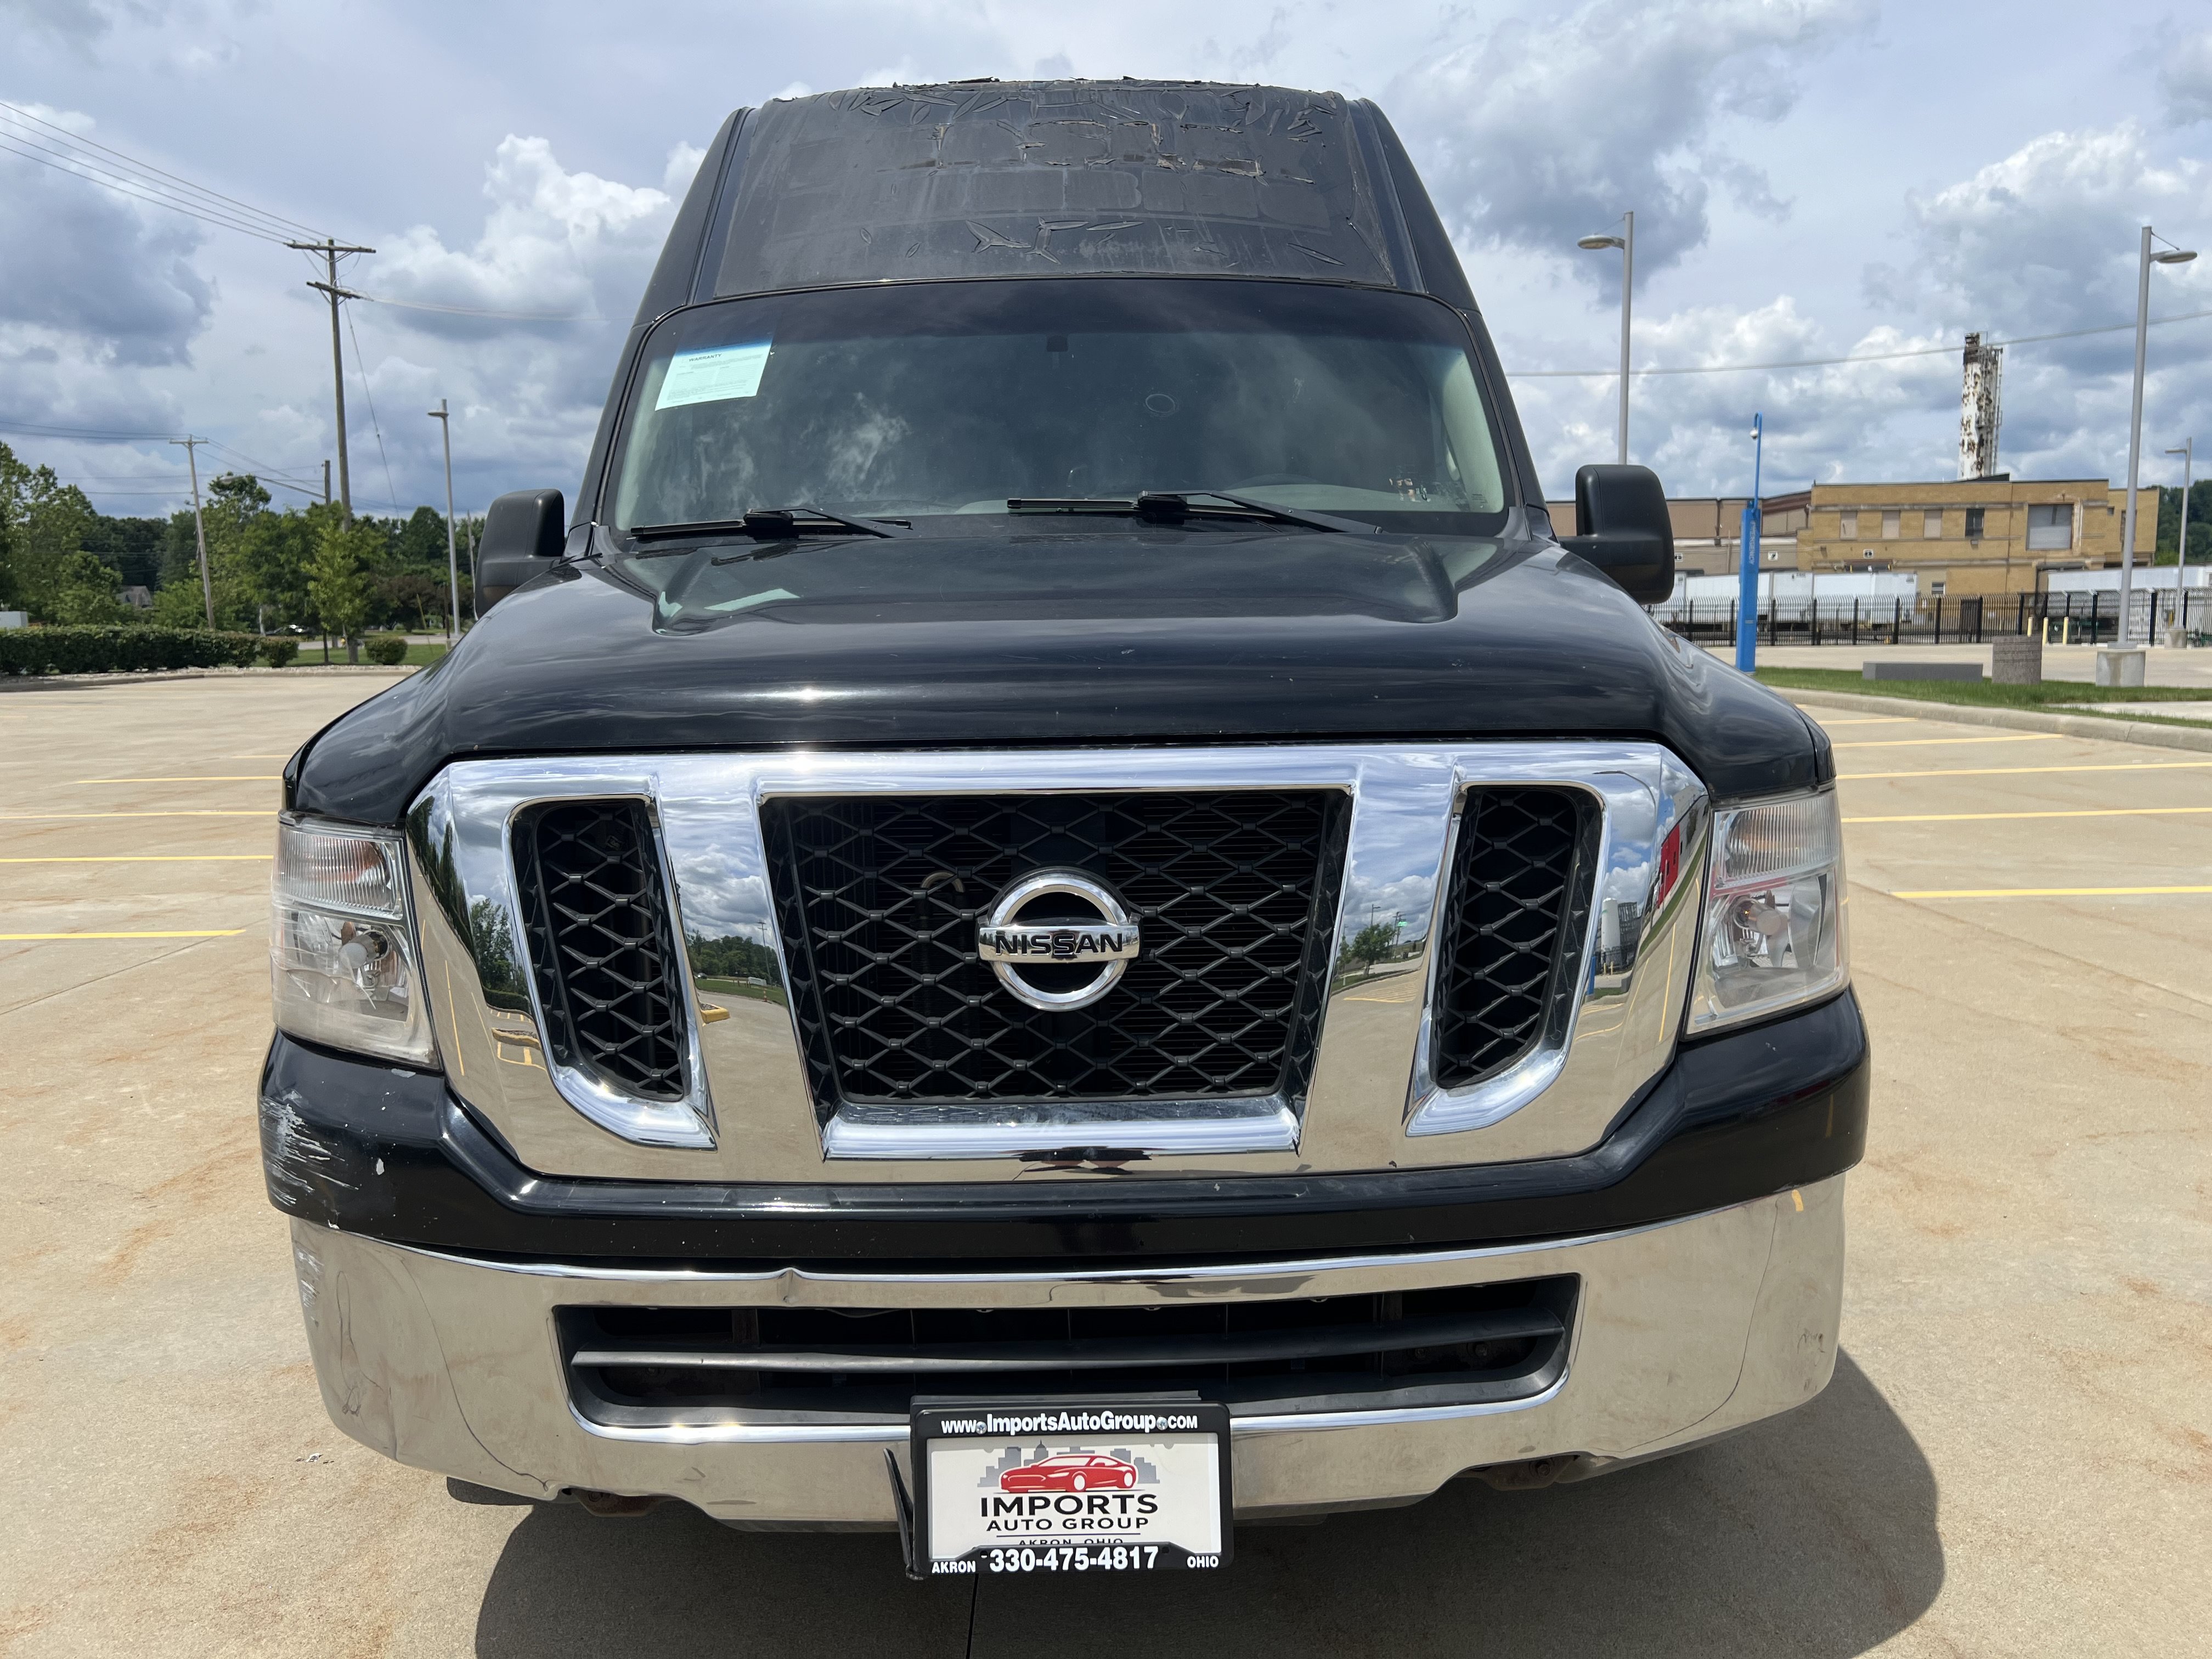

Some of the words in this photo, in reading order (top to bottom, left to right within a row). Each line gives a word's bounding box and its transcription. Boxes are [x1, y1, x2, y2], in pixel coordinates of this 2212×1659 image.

[689, 353, 723, 362] WARRANTY
[995, 933, 1122, 955] NISSAN
[980, 1493, 1159, 1517] IMPORTS
[986, 1518, 1052, 1532] AUTO
[1062, 1517, 1149, 1530] GROUP
[932, 1560, 976, 1573] AKRON
[989, 1546, 1159, 1572] 330-475-4817
[1187, 1555, 1218, 1568] OHIO
